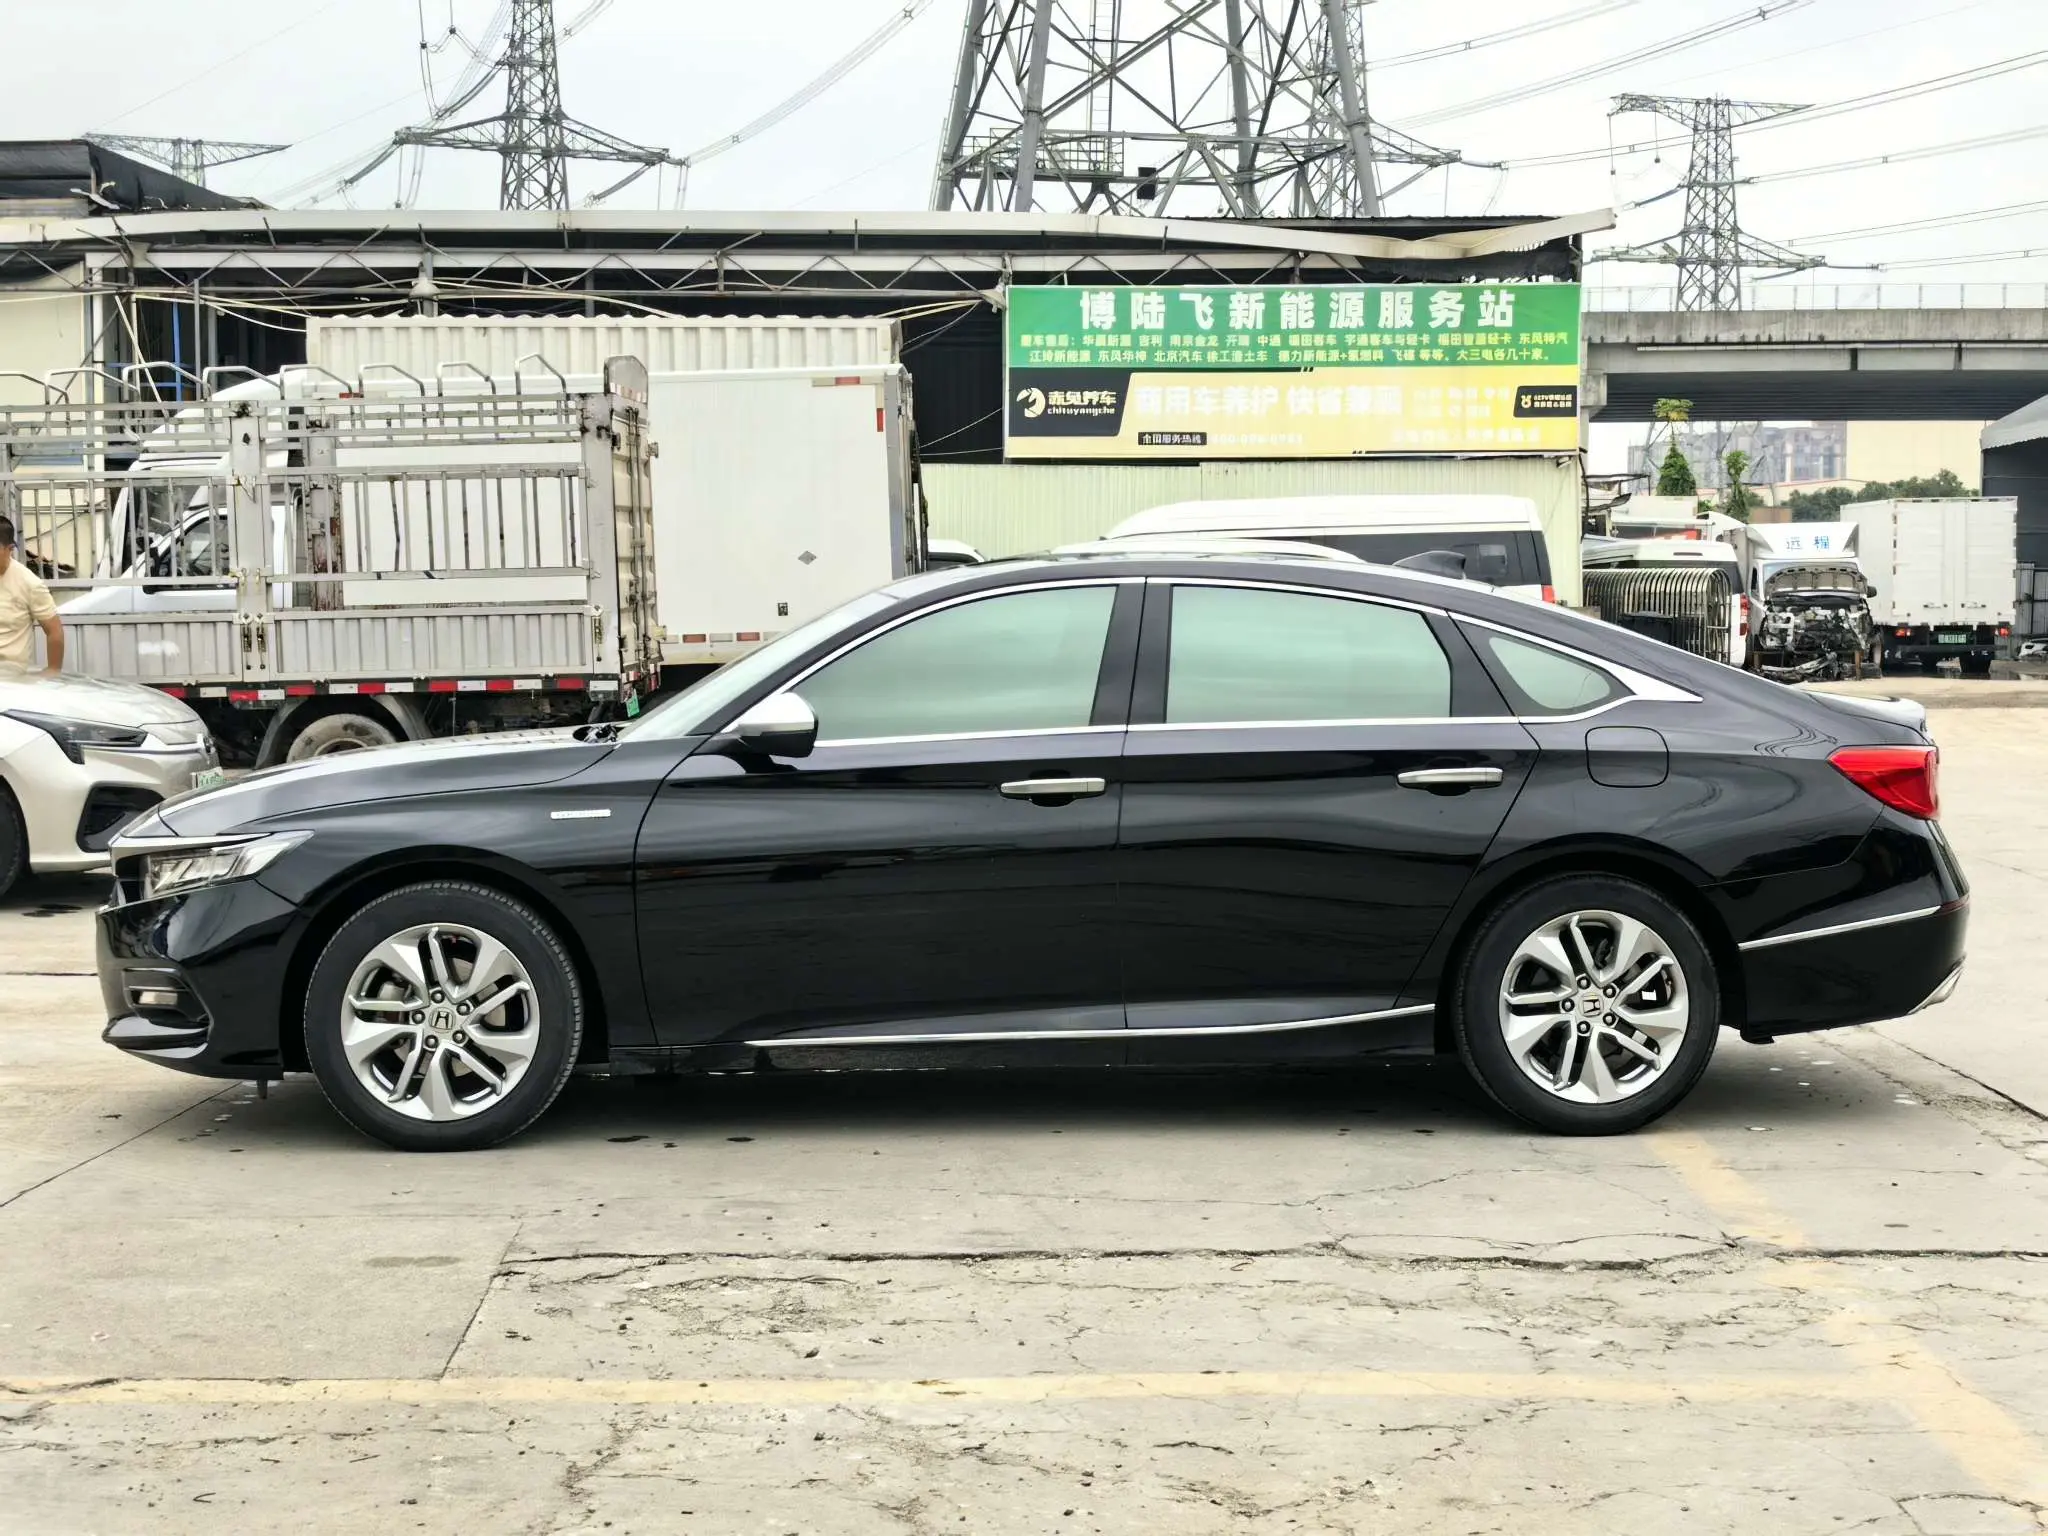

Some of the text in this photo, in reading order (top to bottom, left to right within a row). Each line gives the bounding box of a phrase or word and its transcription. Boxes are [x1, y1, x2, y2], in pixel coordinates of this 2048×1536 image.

[1080, 289, 1516, 330] 博陆飞新能源服务站
[1519, 332, 1568, 345] 东风特汽
[1154, 350, 1202, 362] 北京汽车
